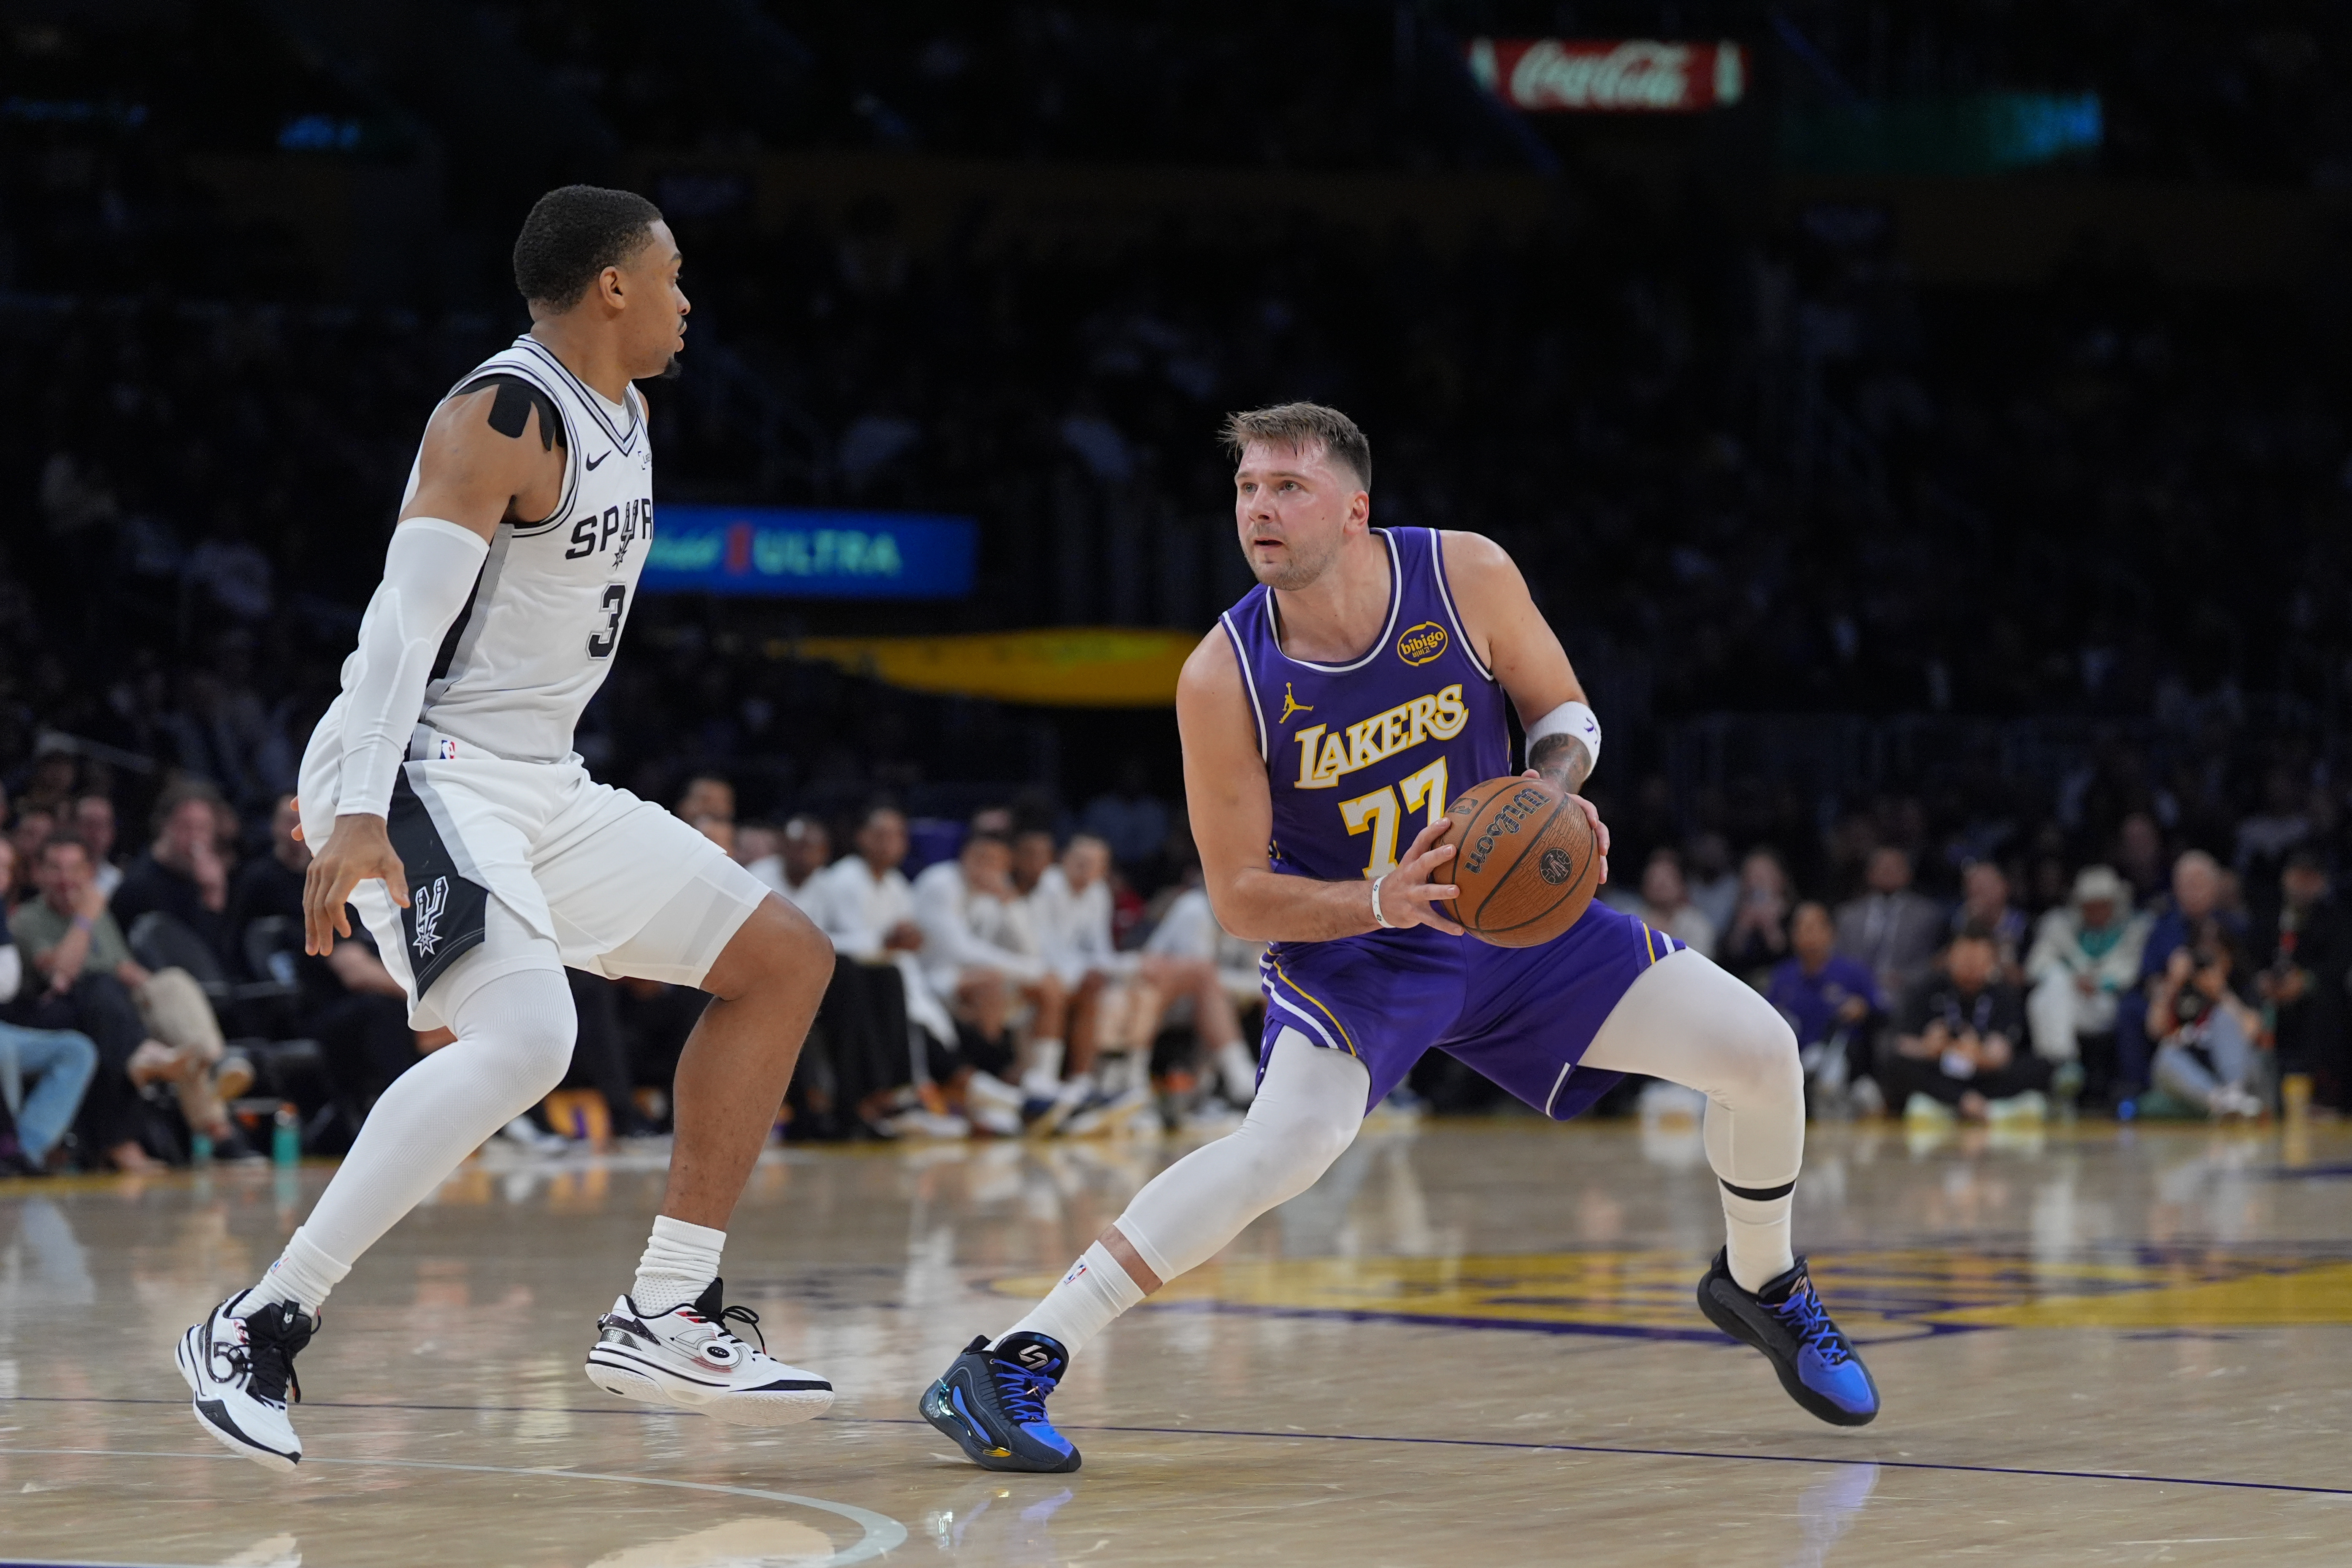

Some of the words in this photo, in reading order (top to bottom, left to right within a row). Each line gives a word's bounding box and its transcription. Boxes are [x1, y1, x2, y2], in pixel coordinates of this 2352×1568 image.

[565, 498, 652, 571] SPUR
[585, 581, 627, 661] 3
[1401, 631, 1444, 655] bibigo
[1294, 684, 1469, 789] LAKERS
[1338, 755, 1448, 880] 77
[1463, 788, 1552, 875] Wilson
